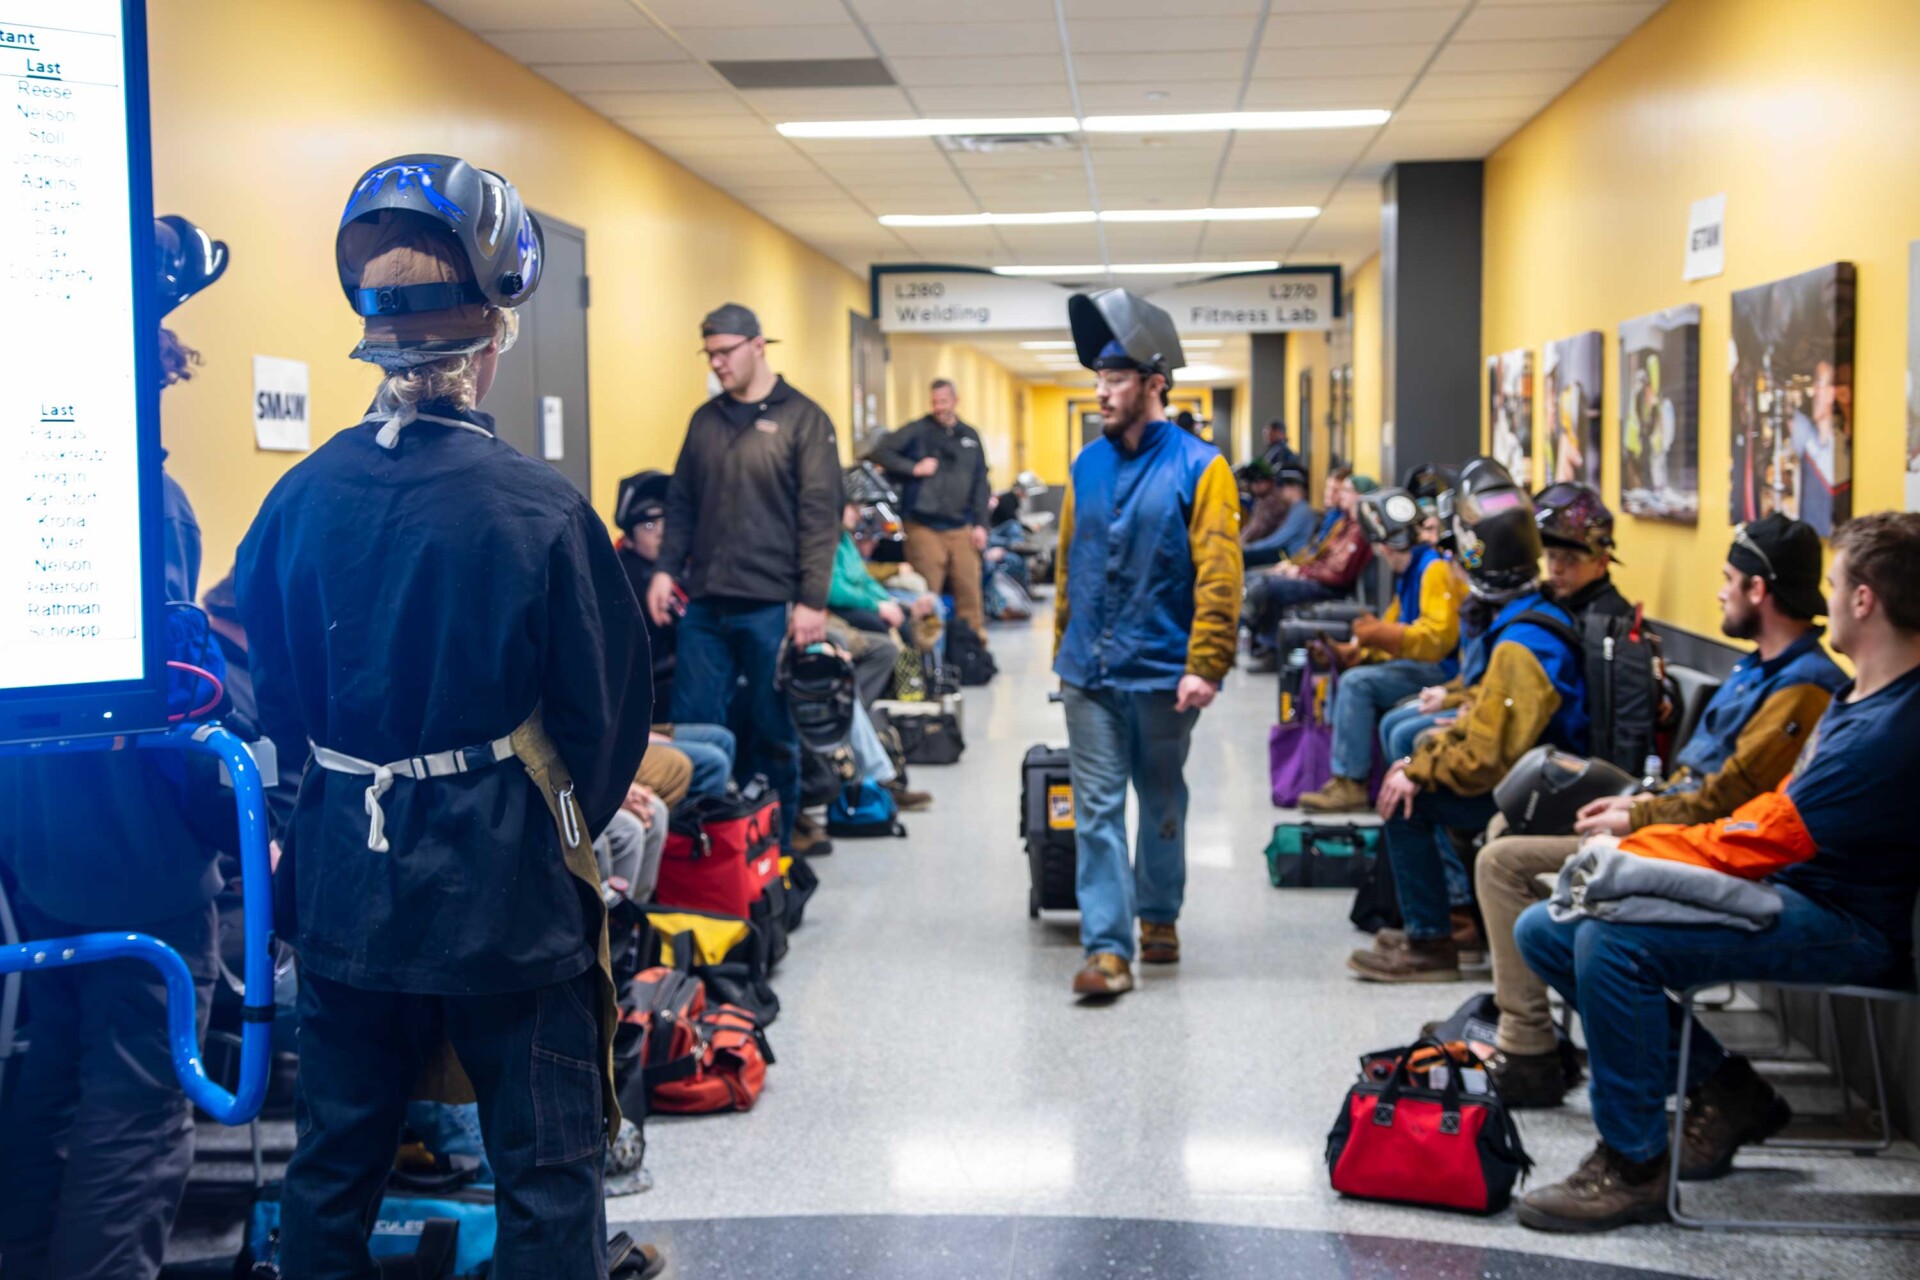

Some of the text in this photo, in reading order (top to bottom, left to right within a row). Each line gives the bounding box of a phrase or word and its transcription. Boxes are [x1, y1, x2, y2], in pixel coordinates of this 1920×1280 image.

[27, 58, 61, 75] Last
[18, 80, 73, 99] Reese
[17, 104, 76, 123] Nelson
[895, 282, 945, 299] L280
[1269, 283, 1318, 300] L270
[896, 304, 990, 324] Welding
[1190, 305, 1318, 325] Fitness Lab
[41, 402, 75, 417] Last
[257, 391, 305, 421] SMAW
[34, 558, 92, 573] Nelson
[27, 581, 100, 595] Peterson
[28, 602, 101, 617] Rathman
